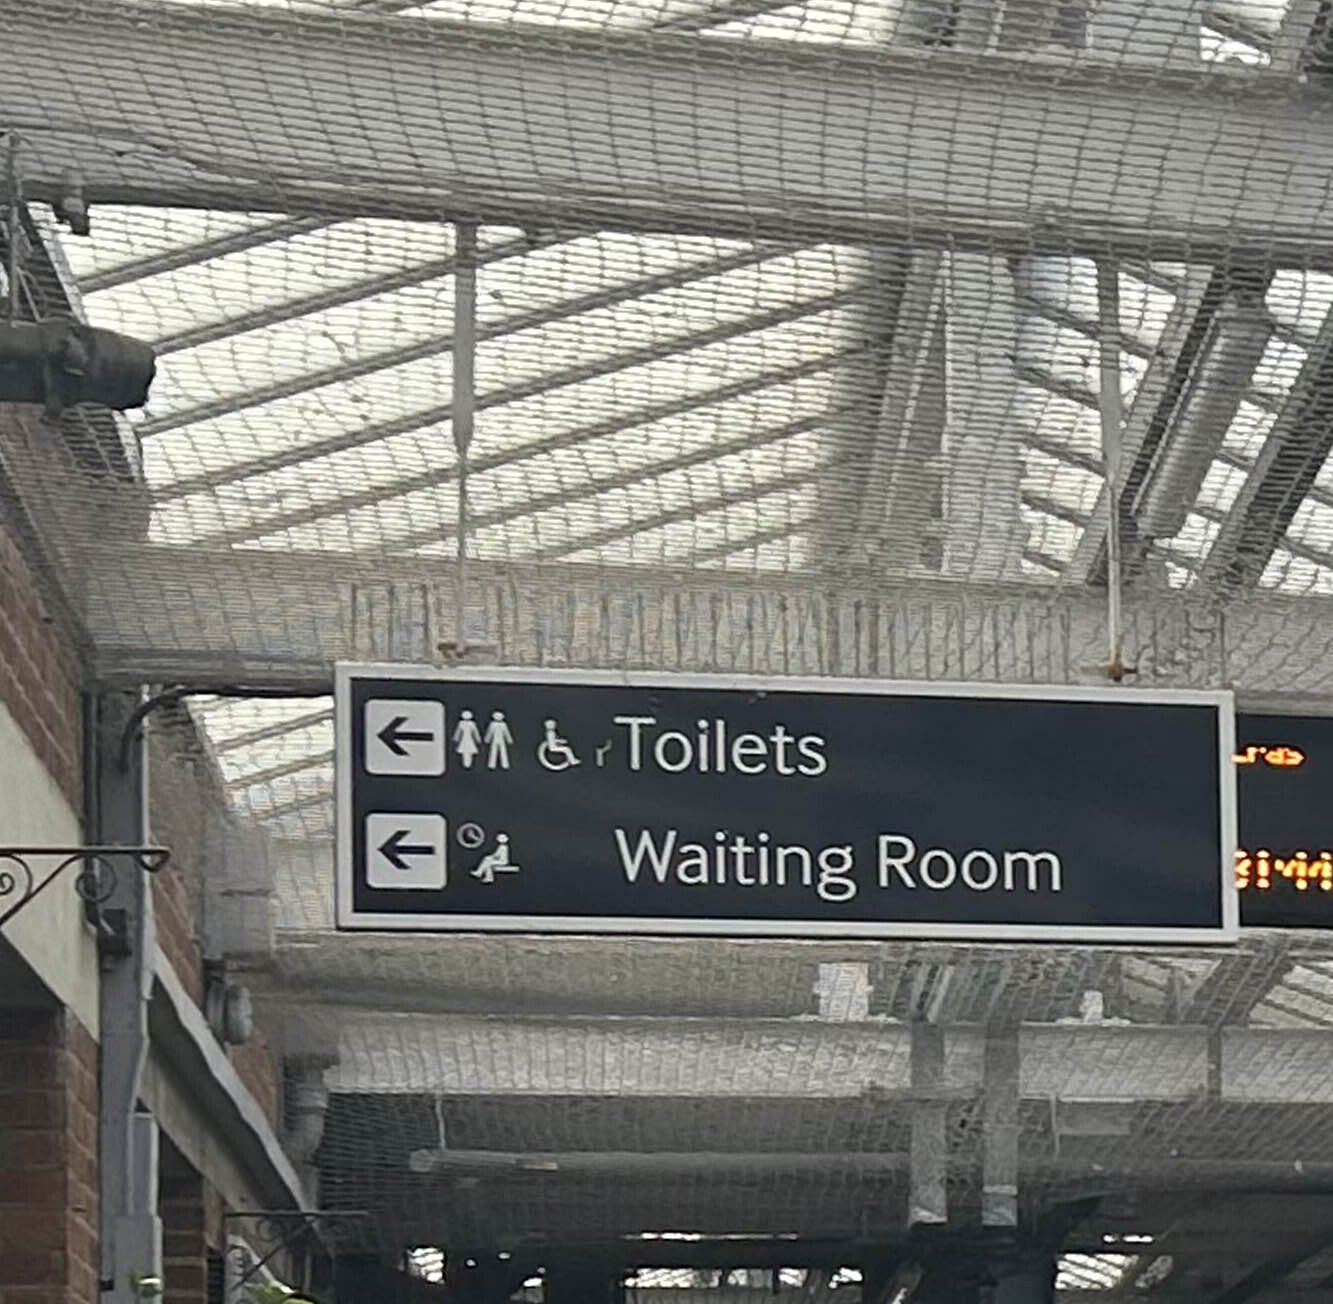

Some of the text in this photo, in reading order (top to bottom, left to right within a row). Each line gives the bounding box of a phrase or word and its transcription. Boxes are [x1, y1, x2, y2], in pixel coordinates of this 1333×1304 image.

[613, 715, 828, 776] Toilets
[614, 828, 1062, 902] Waiting Room
